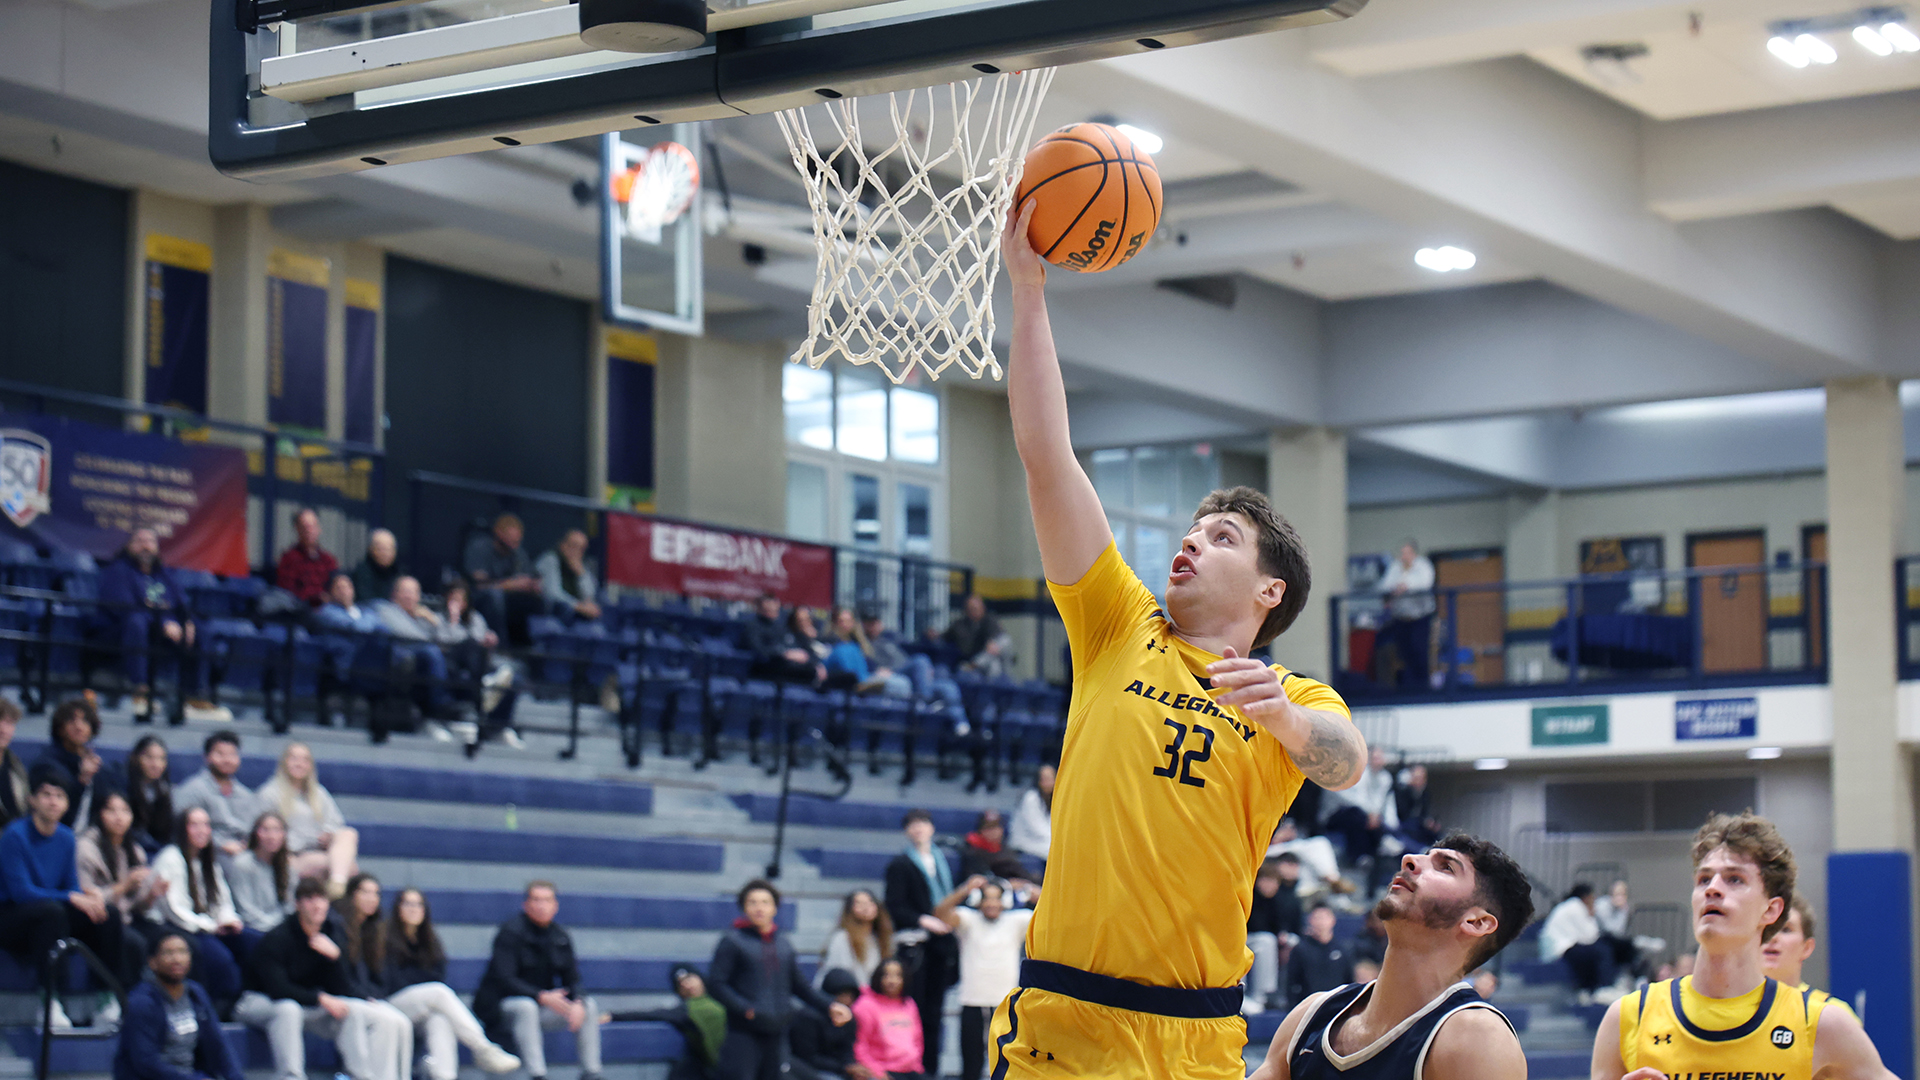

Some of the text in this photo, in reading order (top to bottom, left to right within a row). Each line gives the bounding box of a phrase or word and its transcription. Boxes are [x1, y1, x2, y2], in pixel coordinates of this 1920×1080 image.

[1123, 679, 1257, 743] ALLEGHNY
[1153, 717, 1215, 788] 32
[1772, 1029, 1793, 1044] GB
